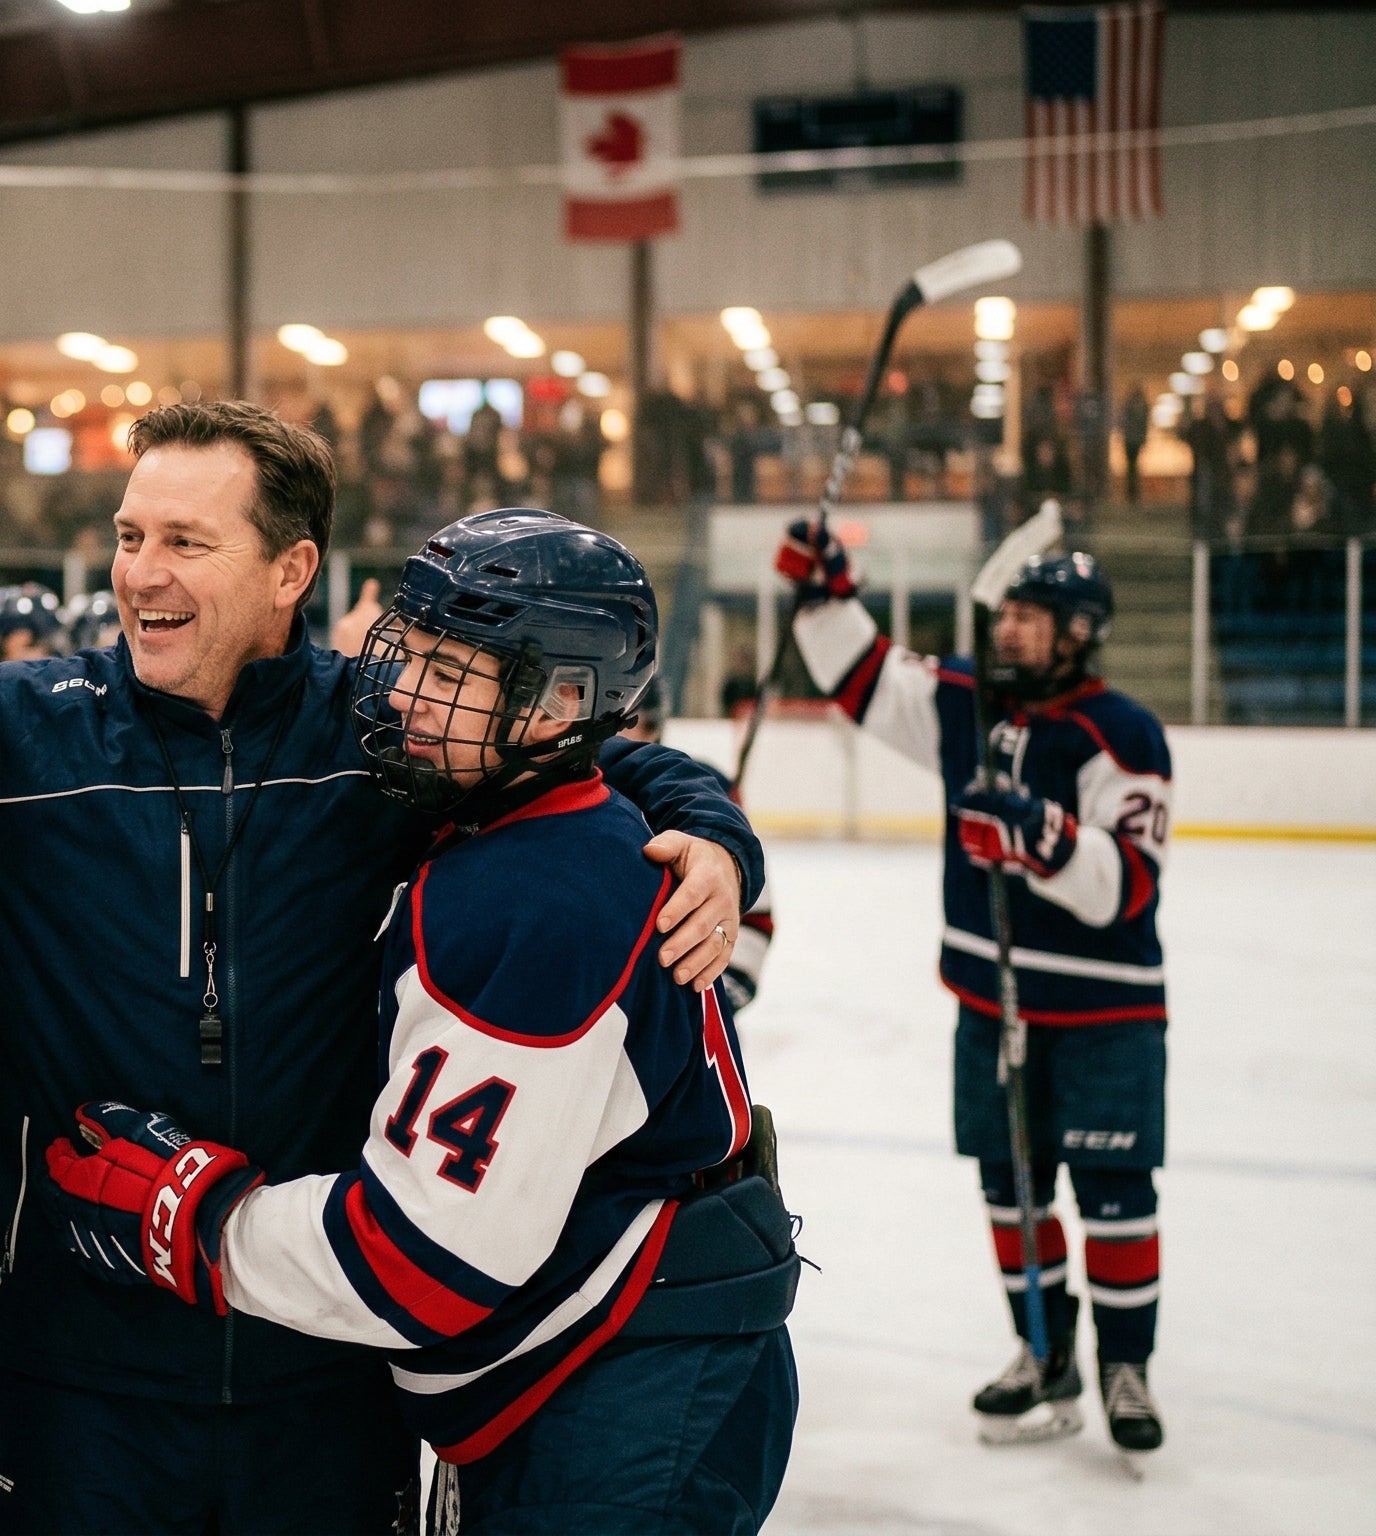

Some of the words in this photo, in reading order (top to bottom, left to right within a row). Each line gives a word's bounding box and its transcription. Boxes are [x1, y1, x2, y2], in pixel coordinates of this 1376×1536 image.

[1117, 792, 1168, 845] 20
[384, 1045, 517, 1194] 14
[147, 1147, 218, 1288] CCM
